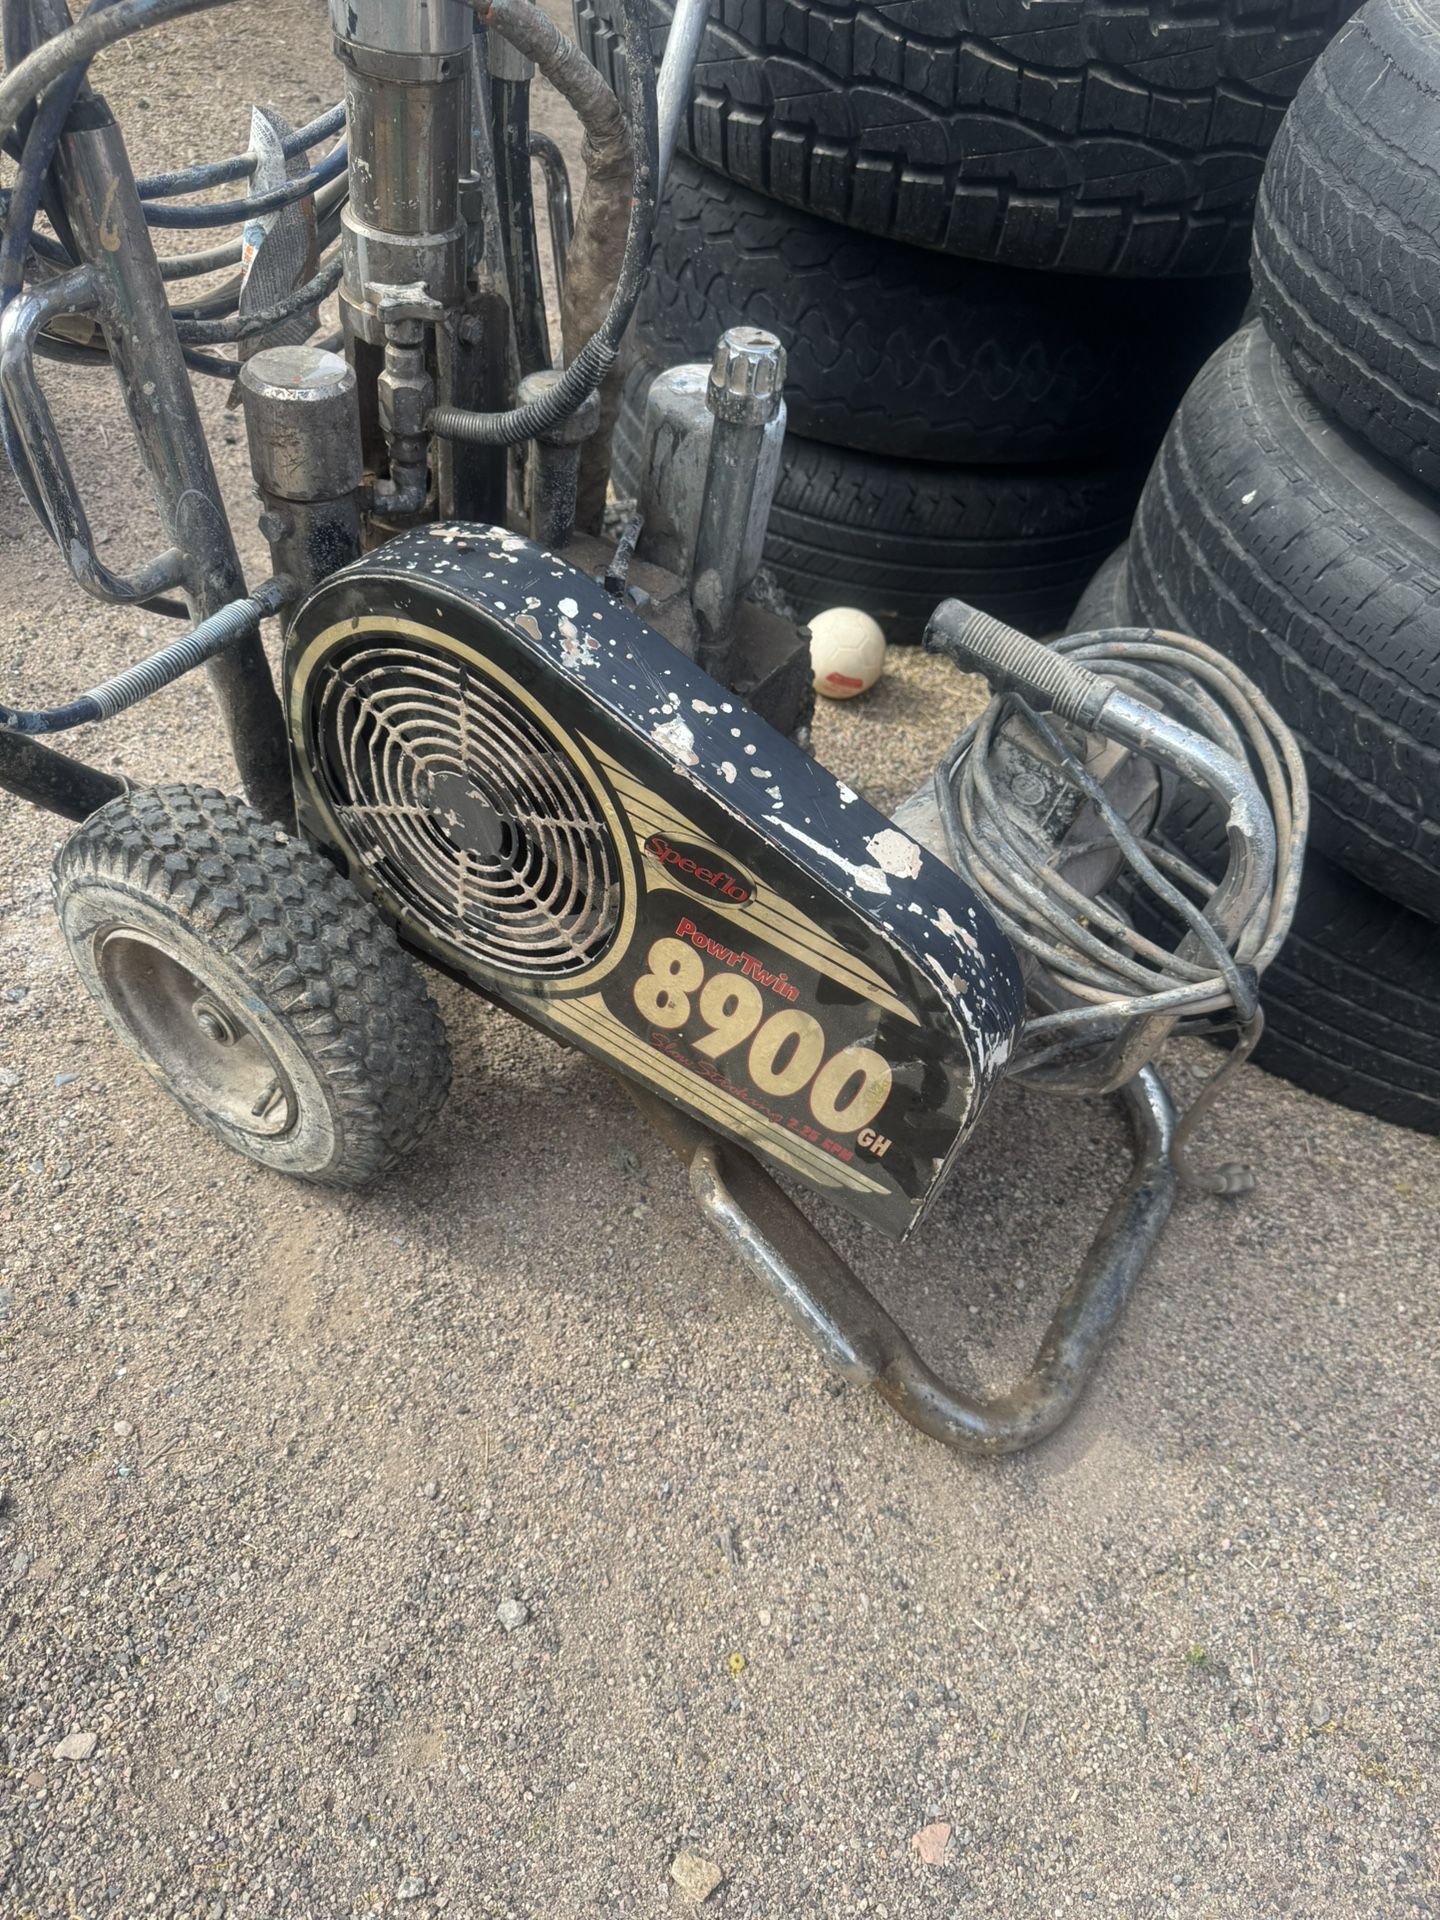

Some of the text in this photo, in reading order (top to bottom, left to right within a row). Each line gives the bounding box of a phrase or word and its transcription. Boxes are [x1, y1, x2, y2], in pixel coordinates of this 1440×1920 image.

[645, 838, 748, 902] Speeflo
[675, 917, 800, 1002] PowrTwin
[633, 937, 893, 1157] 8900 GH
[651, 1032, 693, 1065] Slow
